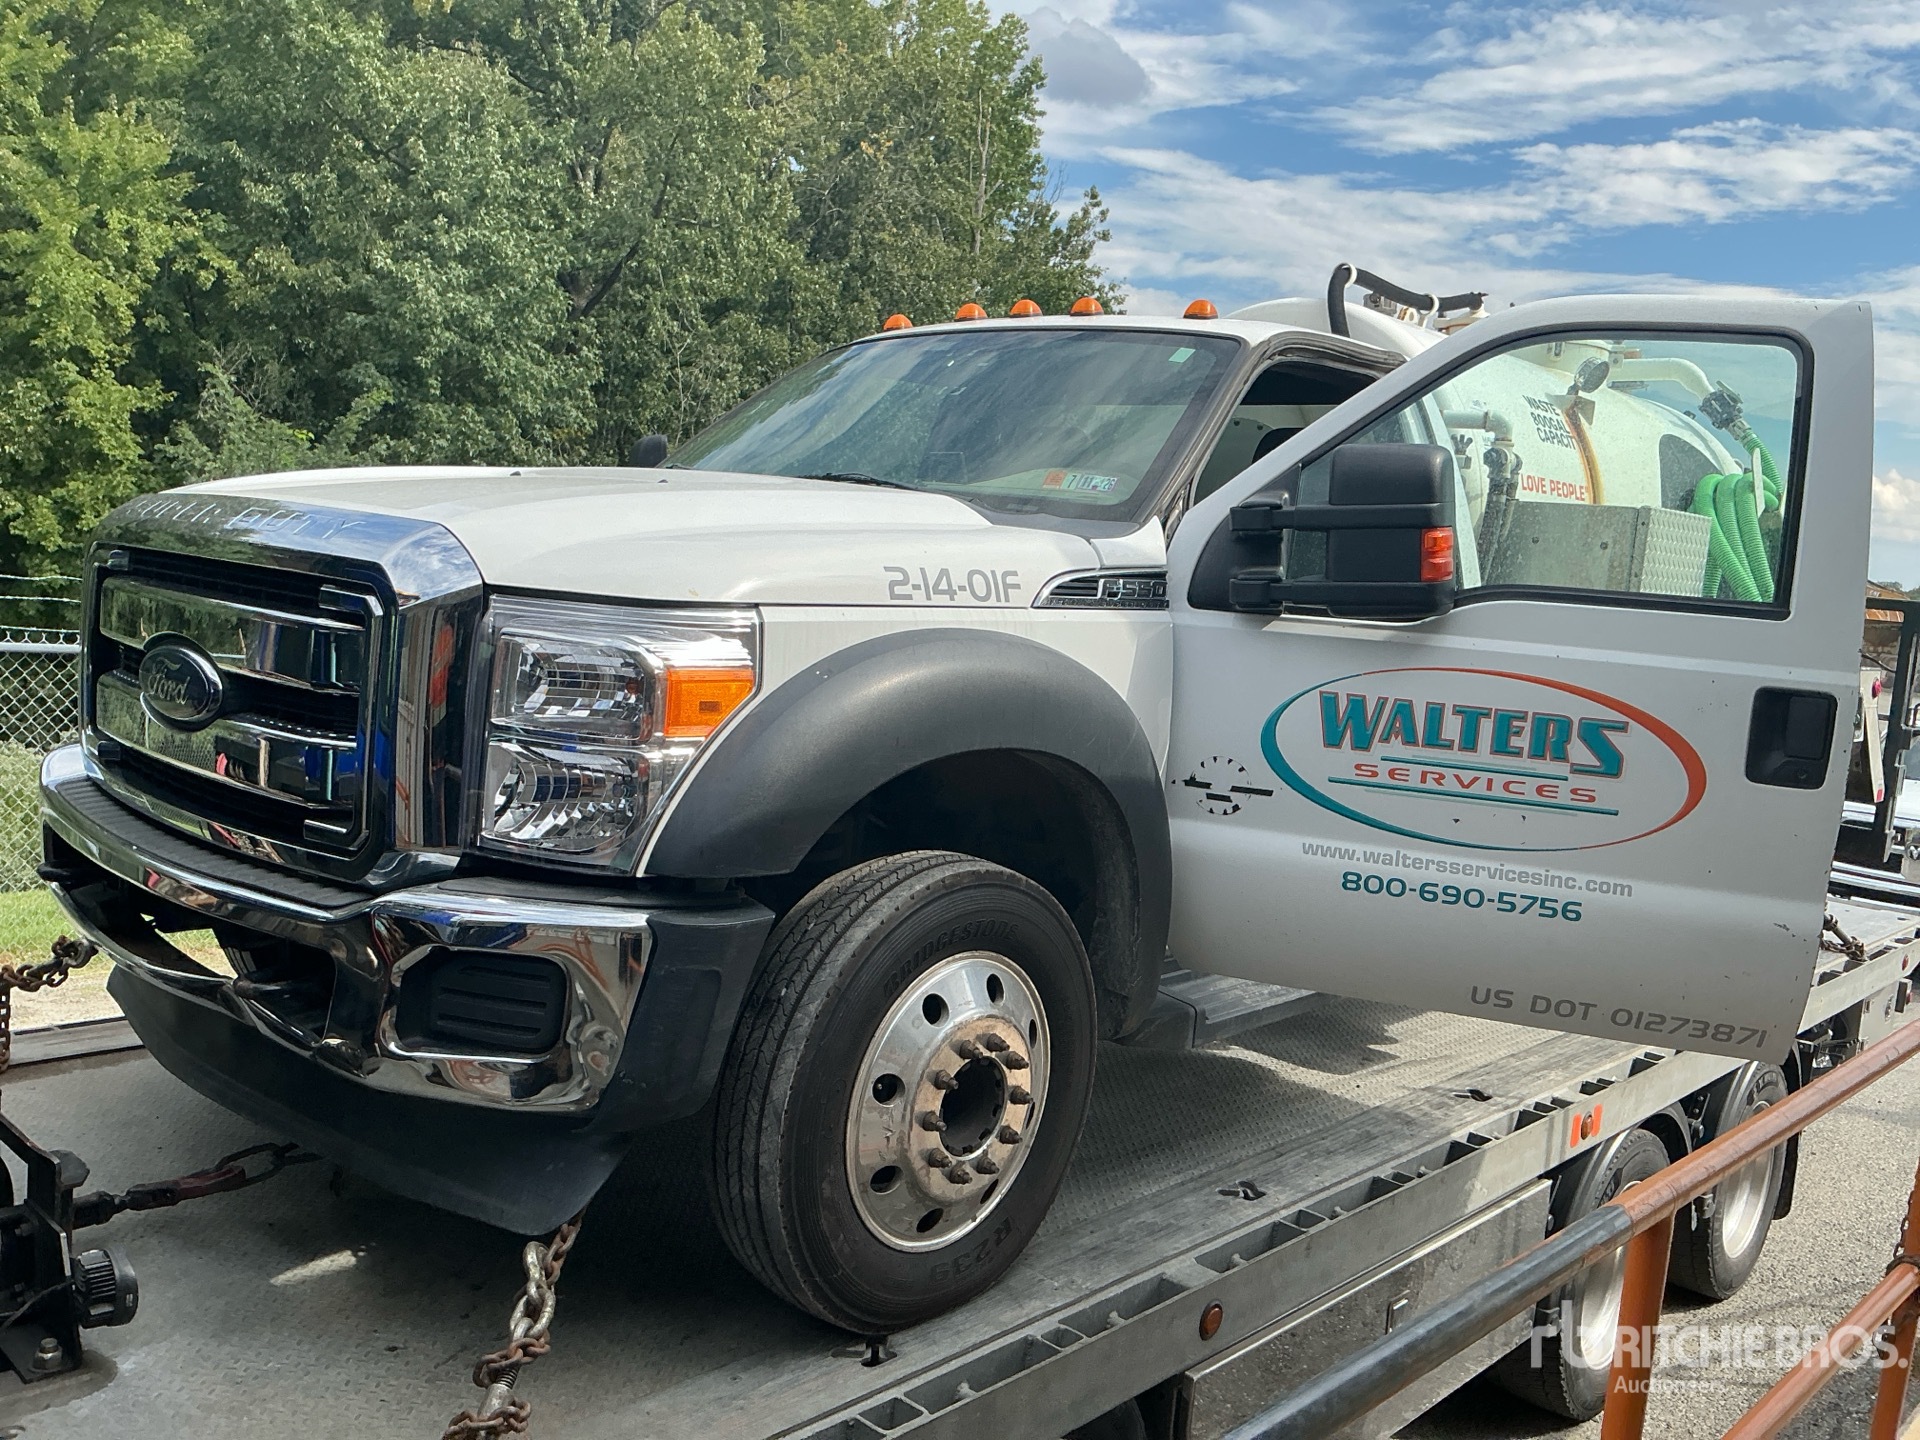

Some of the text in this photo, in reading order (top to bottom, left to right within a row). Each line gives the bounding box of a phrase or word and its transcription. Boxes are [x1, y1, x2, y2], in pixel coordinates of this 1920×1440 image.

[1522, 395, 1561, 417] WASTE
[1536, 427, 1577, 450] CAPACIT
[1520, 473, 1548, 494] LOVE
[147, 657, 191, 706] Ford
[1319, 690, 1629, 779] WALTERS
[1353, 763, 1597, 804] SERVICES
[1301, 840, 1634, 898] www.waltersservicesinc.com
[1340, 870, 1583, 922] 800-690-5756
[883, 917, 1020, 996] BRIDGESTONE
[1470, 985, 1768, 1049] US DOT 01273871
